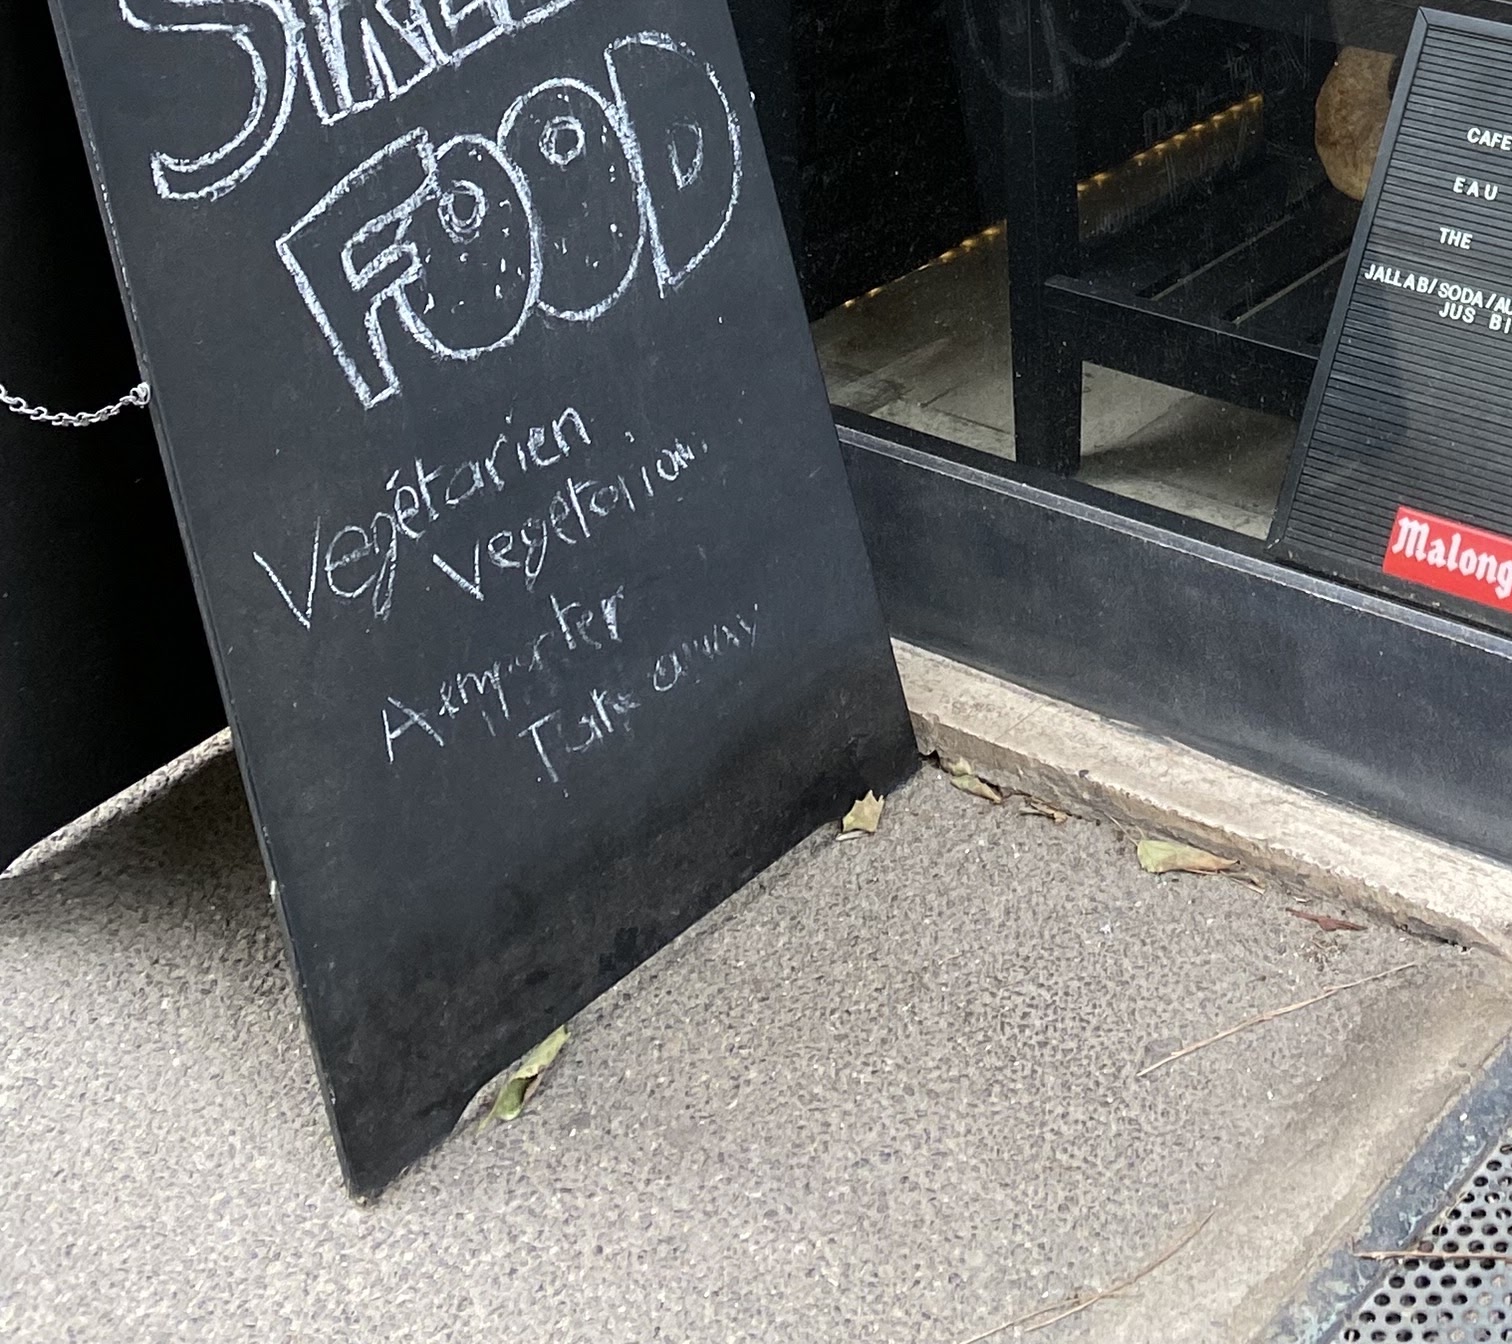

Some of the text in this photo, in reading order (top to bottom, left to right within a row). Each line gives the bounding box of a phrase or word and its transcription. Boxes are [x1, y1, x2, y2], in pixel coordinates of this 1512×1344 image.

[1453, 177, 1499, 201] EAU
[276, 29, 743, 410] FOOD
[1438, 227, 1473, 250] THE
[1438, 302, 1477, 325] JUS
